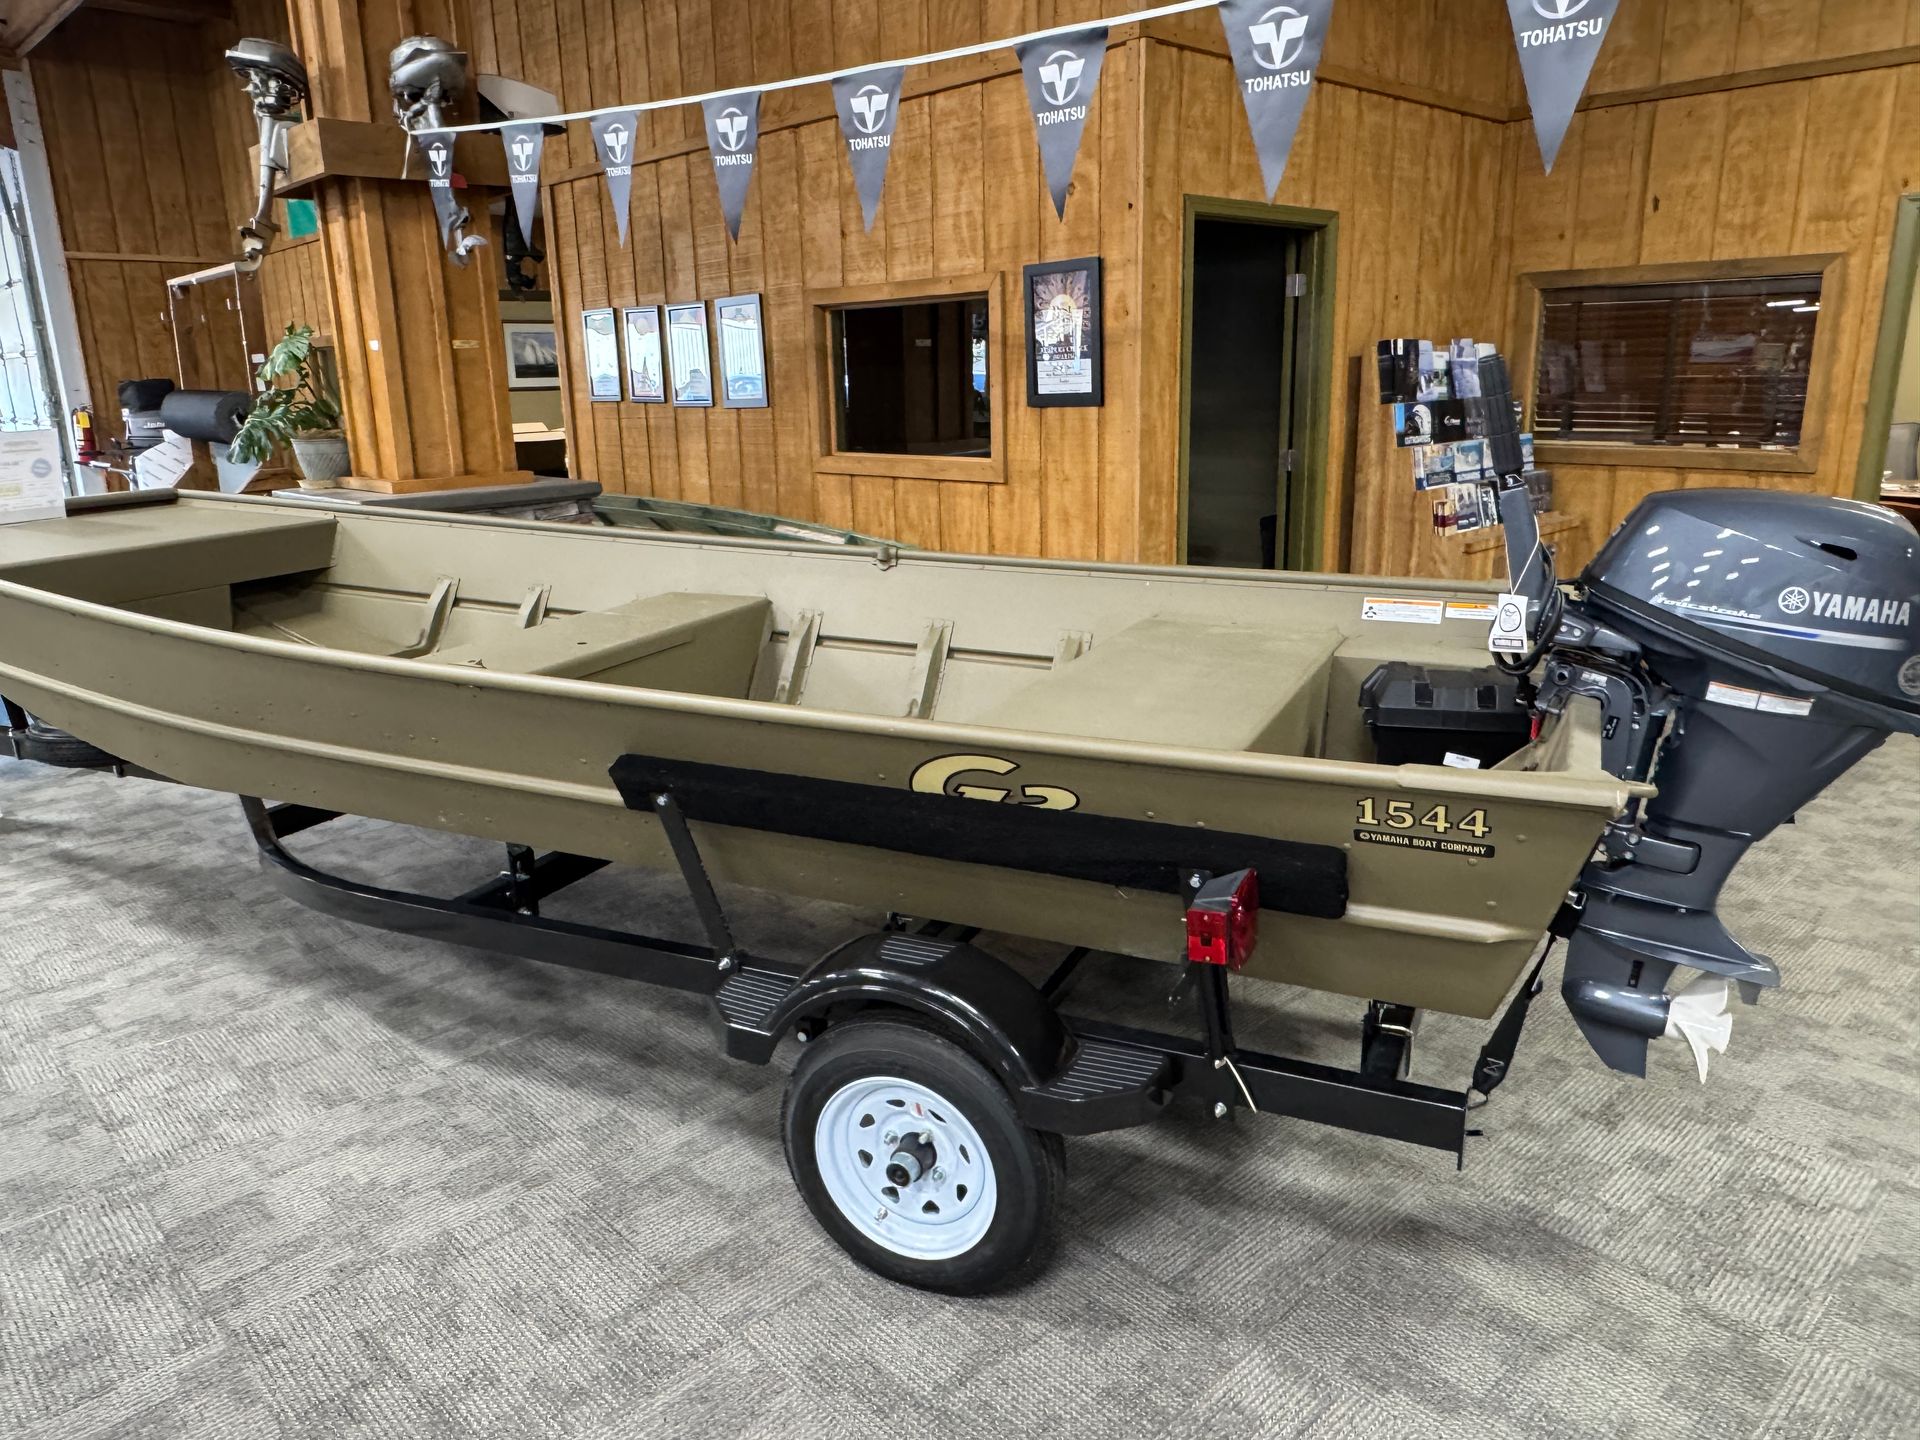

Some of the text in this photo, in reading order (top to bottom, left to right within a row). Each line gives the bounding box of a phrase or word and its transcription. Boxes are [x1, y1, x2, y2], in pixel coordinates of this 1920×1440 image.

[1520, 18, 1603, 48] TOHATSU
[1245, 70, 1311, 94] TOHATSU
[1037, 105, 1086, 126] TOHATSU
[849, 134, 891, 151] TOHATSU
[714, 153, 753, 166] TOHATSU
[1812, 591, 1911, 626] YAMAHA
[1356, 797, 1492, 838] 1544
[1370, 833, 1487, 855] YAMAHA BOAT COMPANY
